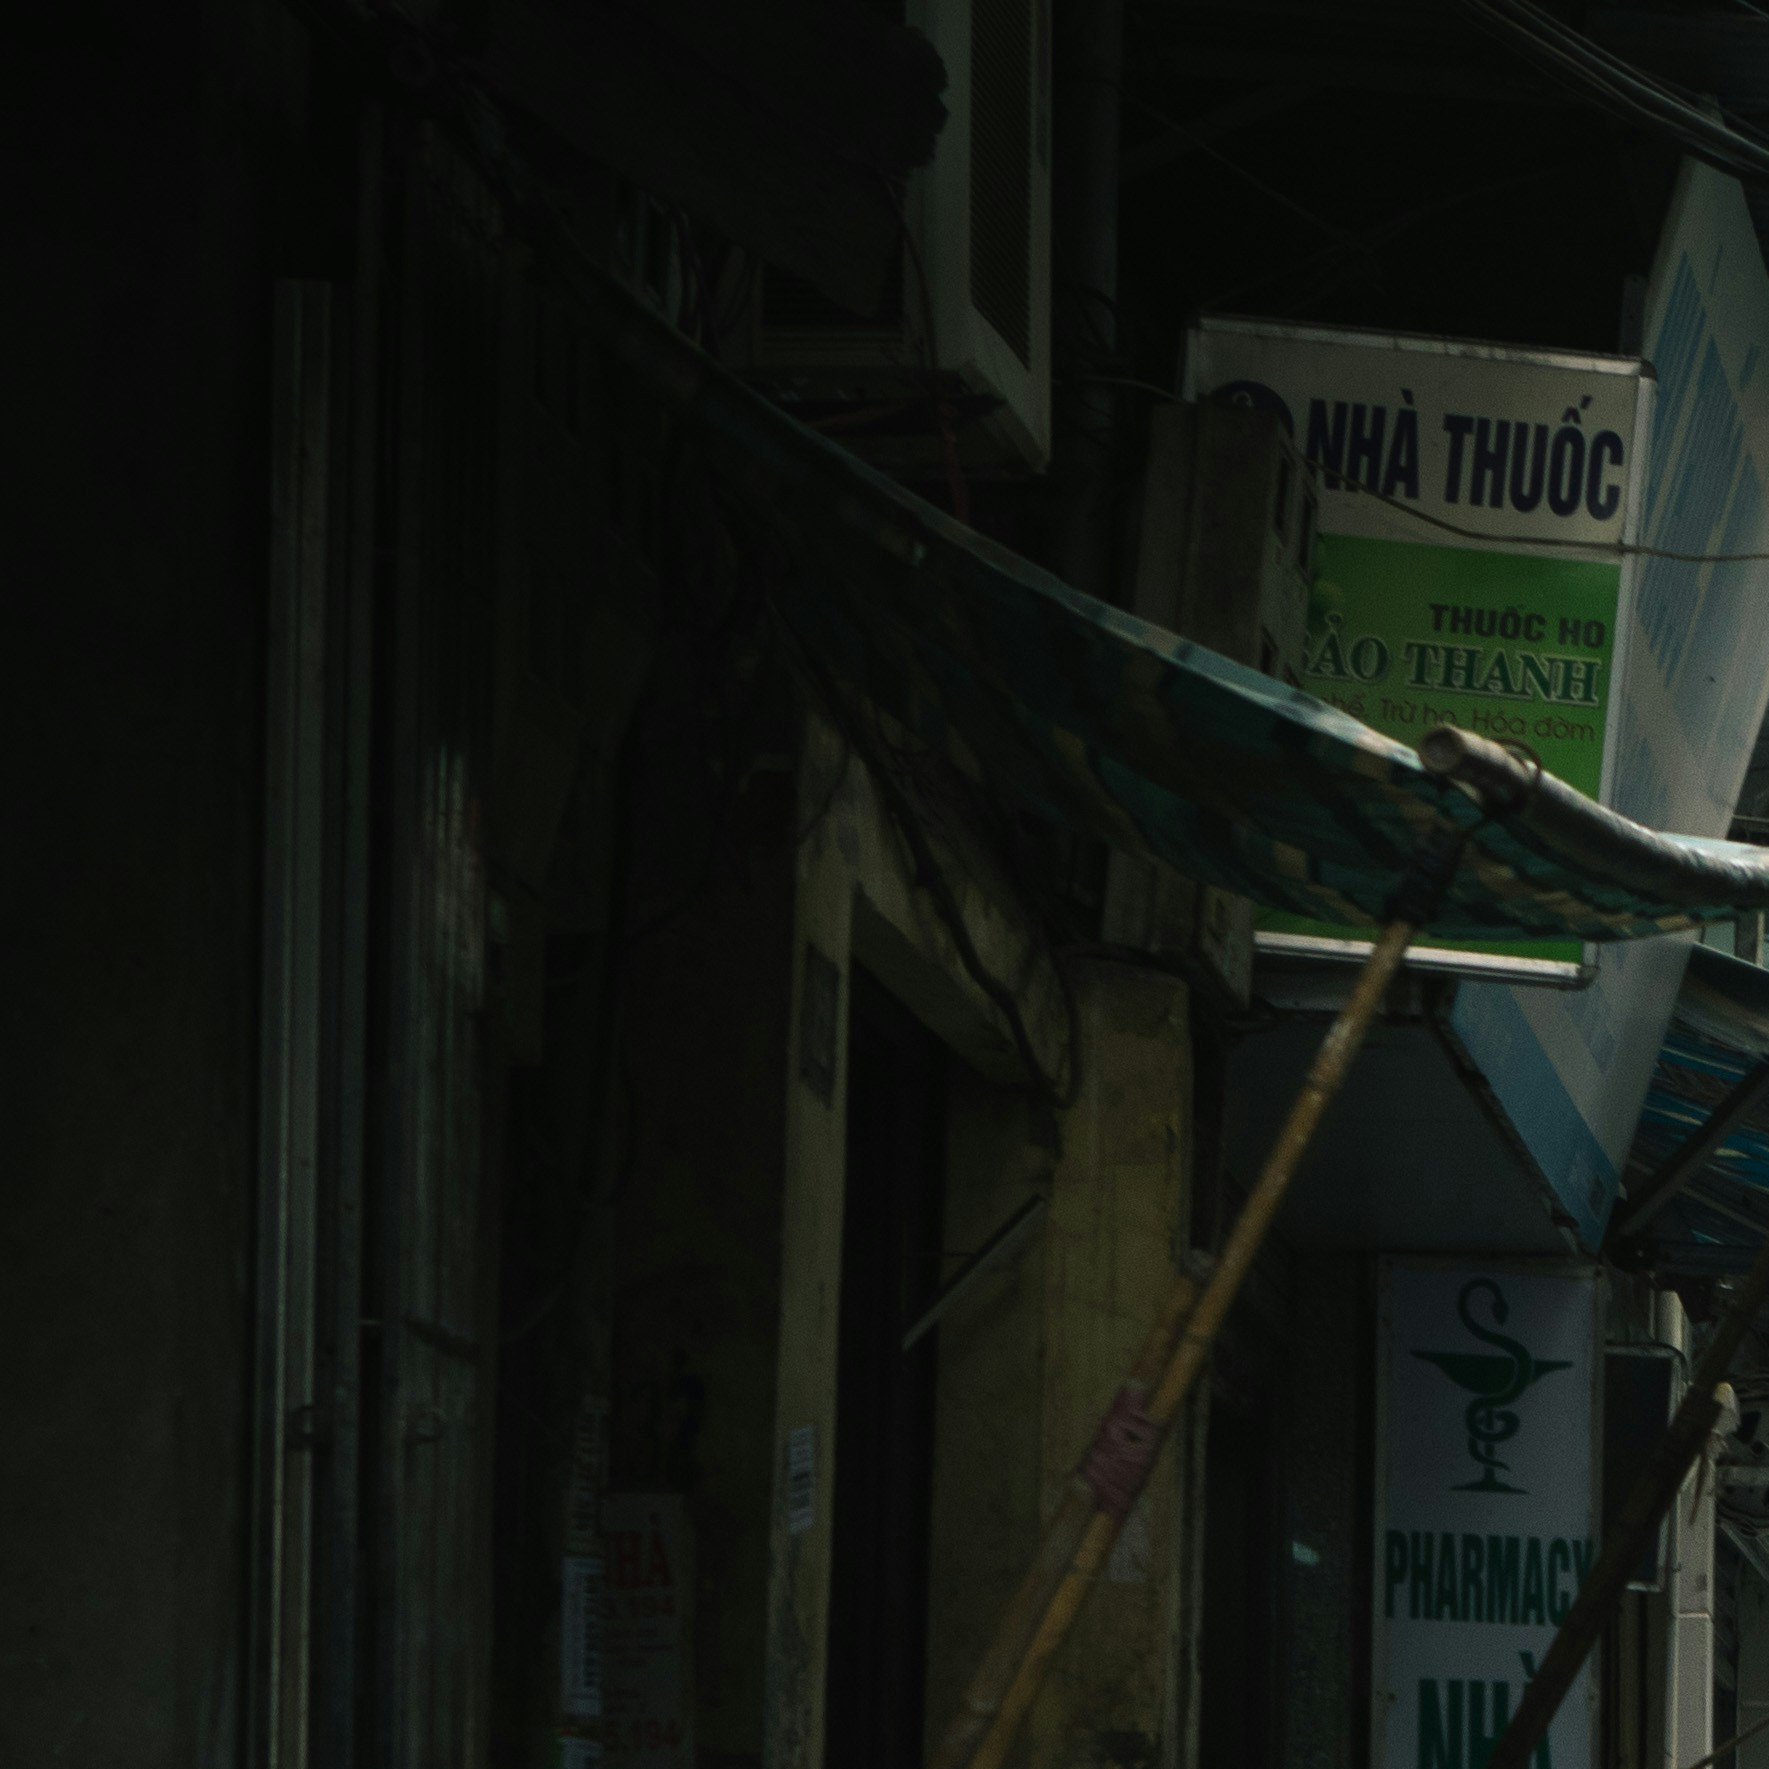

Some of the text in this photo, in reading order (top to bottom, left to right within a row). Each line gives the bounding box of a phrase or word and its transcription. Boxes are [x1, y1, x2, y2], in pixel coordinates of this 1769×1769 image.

[1306, 388, 1624, 521] NHÀ THUỐC
[1302, 611, 1602, 706] ẢO THANH
[1558, 616, 1606, 650] HO
